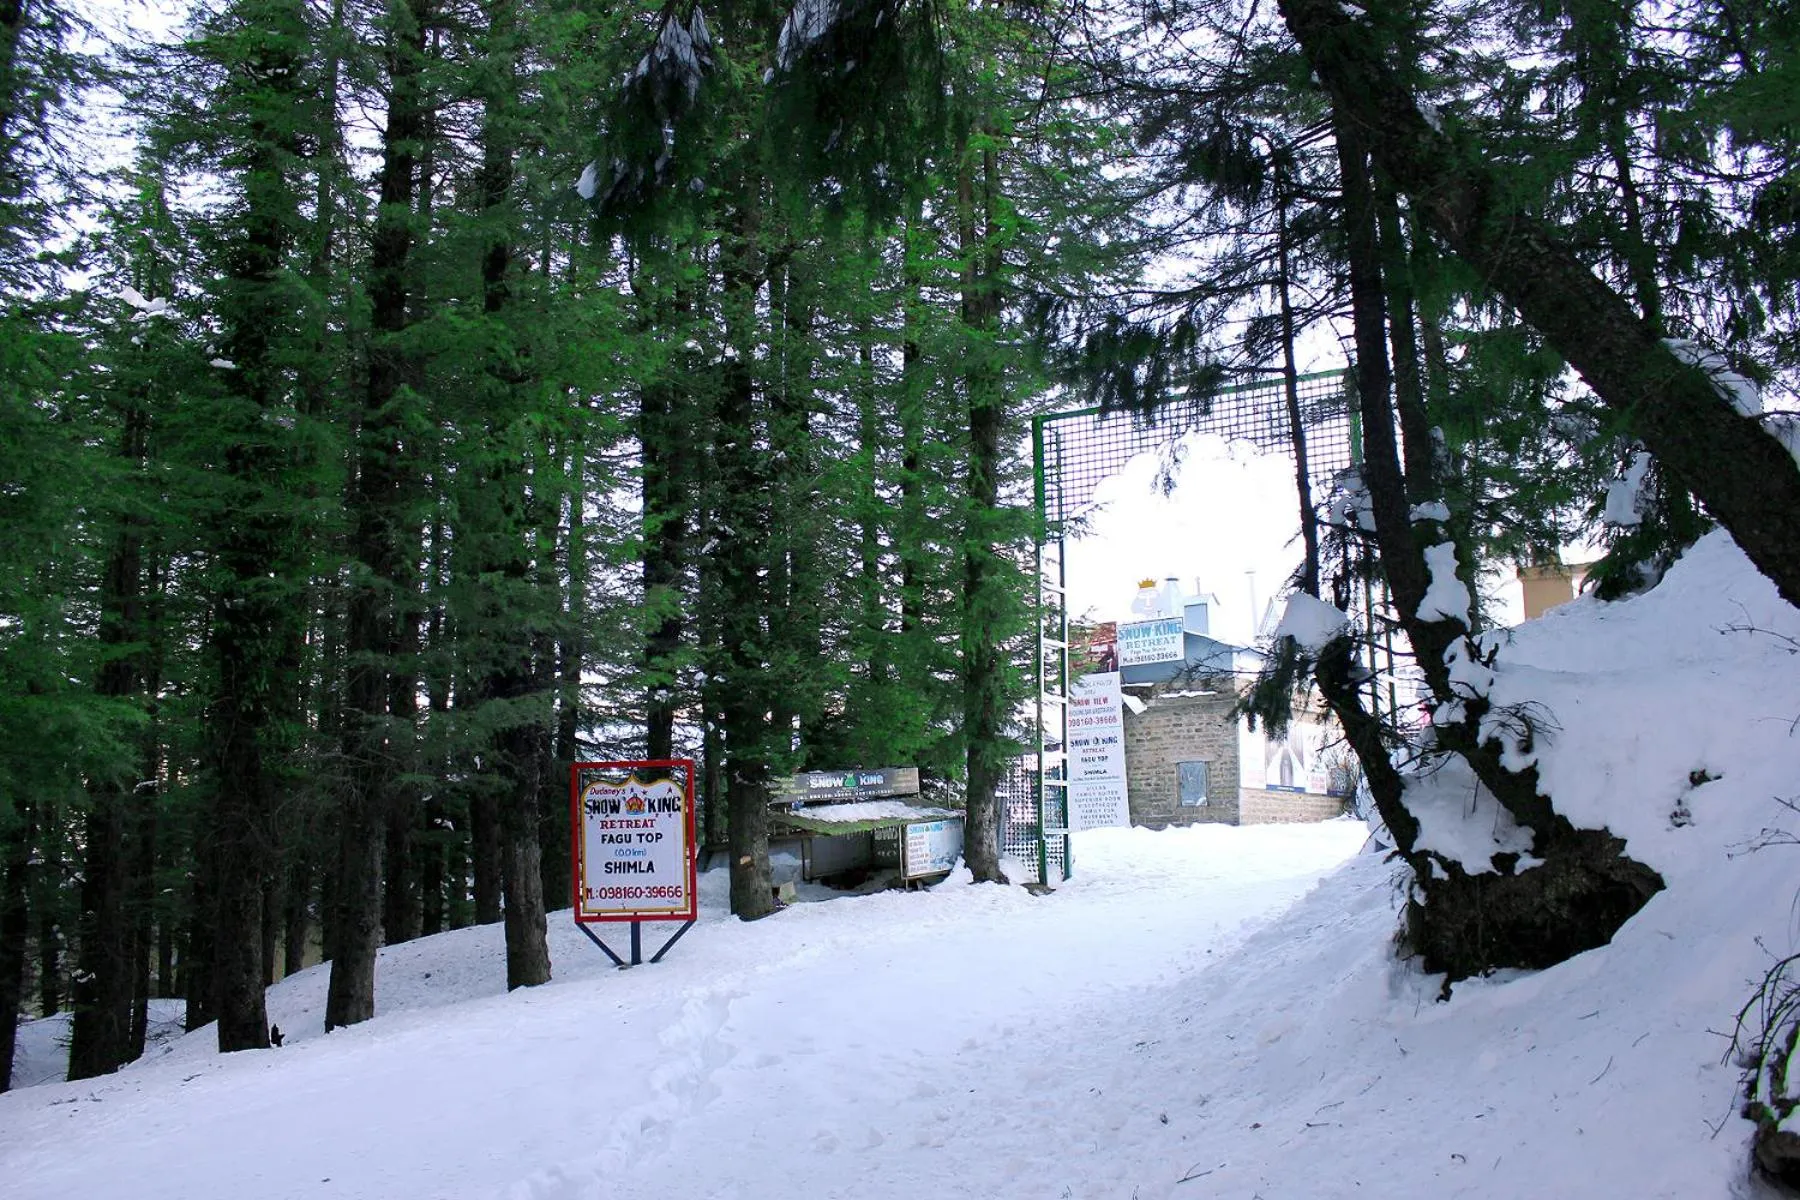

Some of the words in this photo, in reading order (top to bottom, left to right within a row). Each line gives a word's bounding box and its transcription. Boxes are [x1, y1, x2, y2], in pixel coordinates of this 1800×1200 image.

[1126, 636, 1176, 650] RETREAT
[809, 776, 844, 788] SNOW
[860, 773, 884, 786] KING
[584, 798, 621, 815] SNOW
[647, 796, 681, 813] KING
[600, 818, 656, 830] RETREAT
[601, 833, 632, 844] FAGU
[636, 832, 663, 843] TOP
[604, 861, 655, 874] SHIMLA
